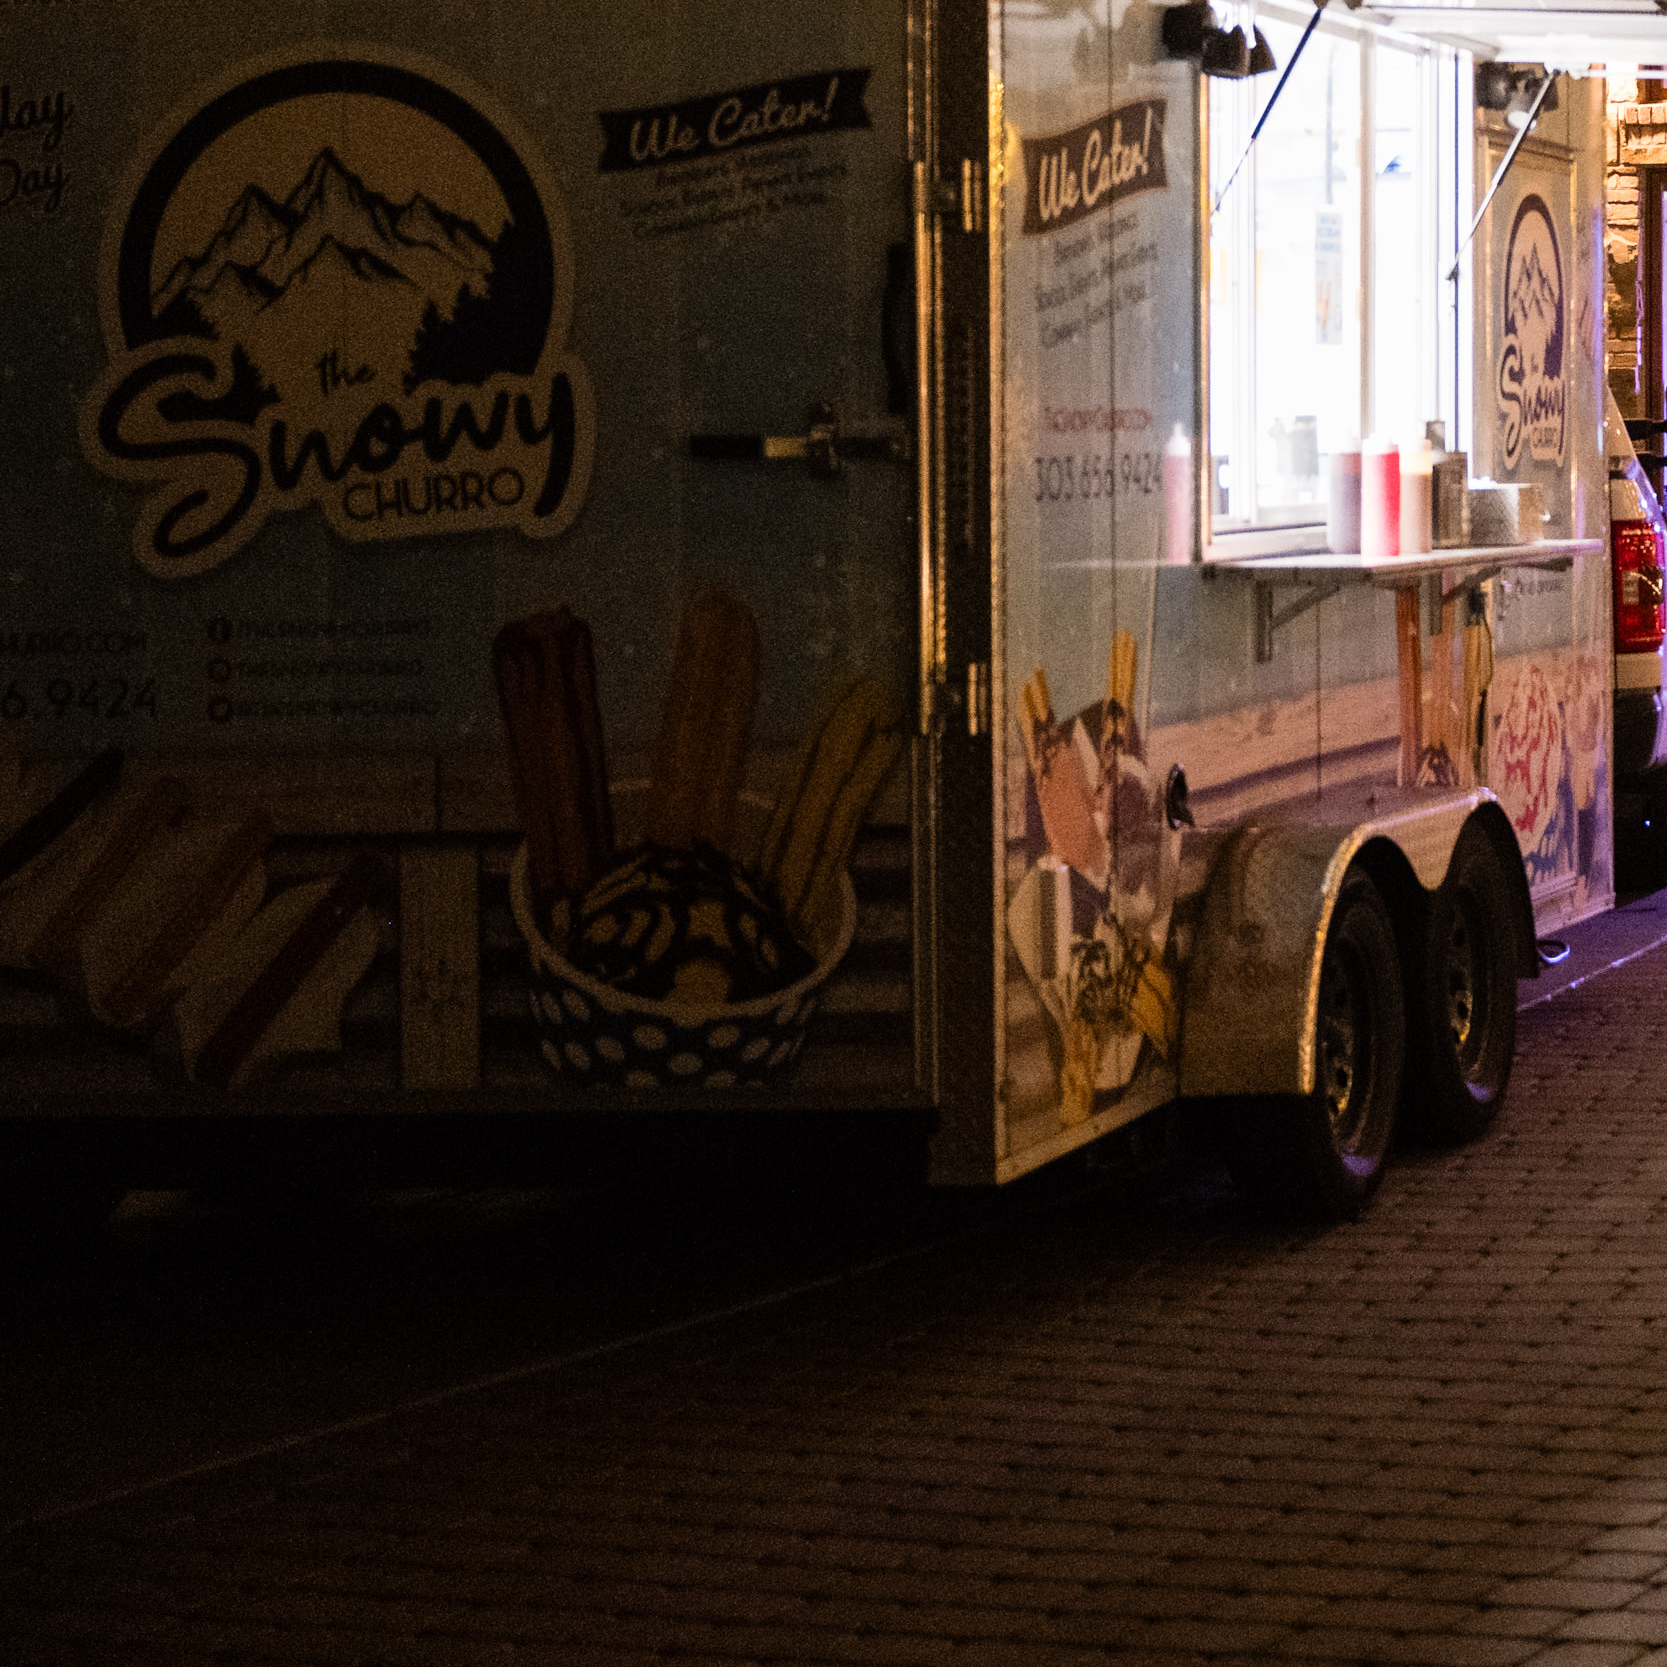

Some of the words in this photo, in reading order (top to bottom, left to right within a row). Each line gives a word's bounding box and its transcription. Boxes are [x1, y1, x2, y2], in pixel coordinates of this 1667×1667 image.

[629, 113, 699, 161] We
[707, 76, 839, 147] Cater!
[1039, 148, 1080, 220] We
[1081, 107, 1152, 206] Cater!
[98, 353, 576, 557] Snowy
[1500, 344, 1565, 457] Snowy
[343, 467, 525, 520] CHURRO
